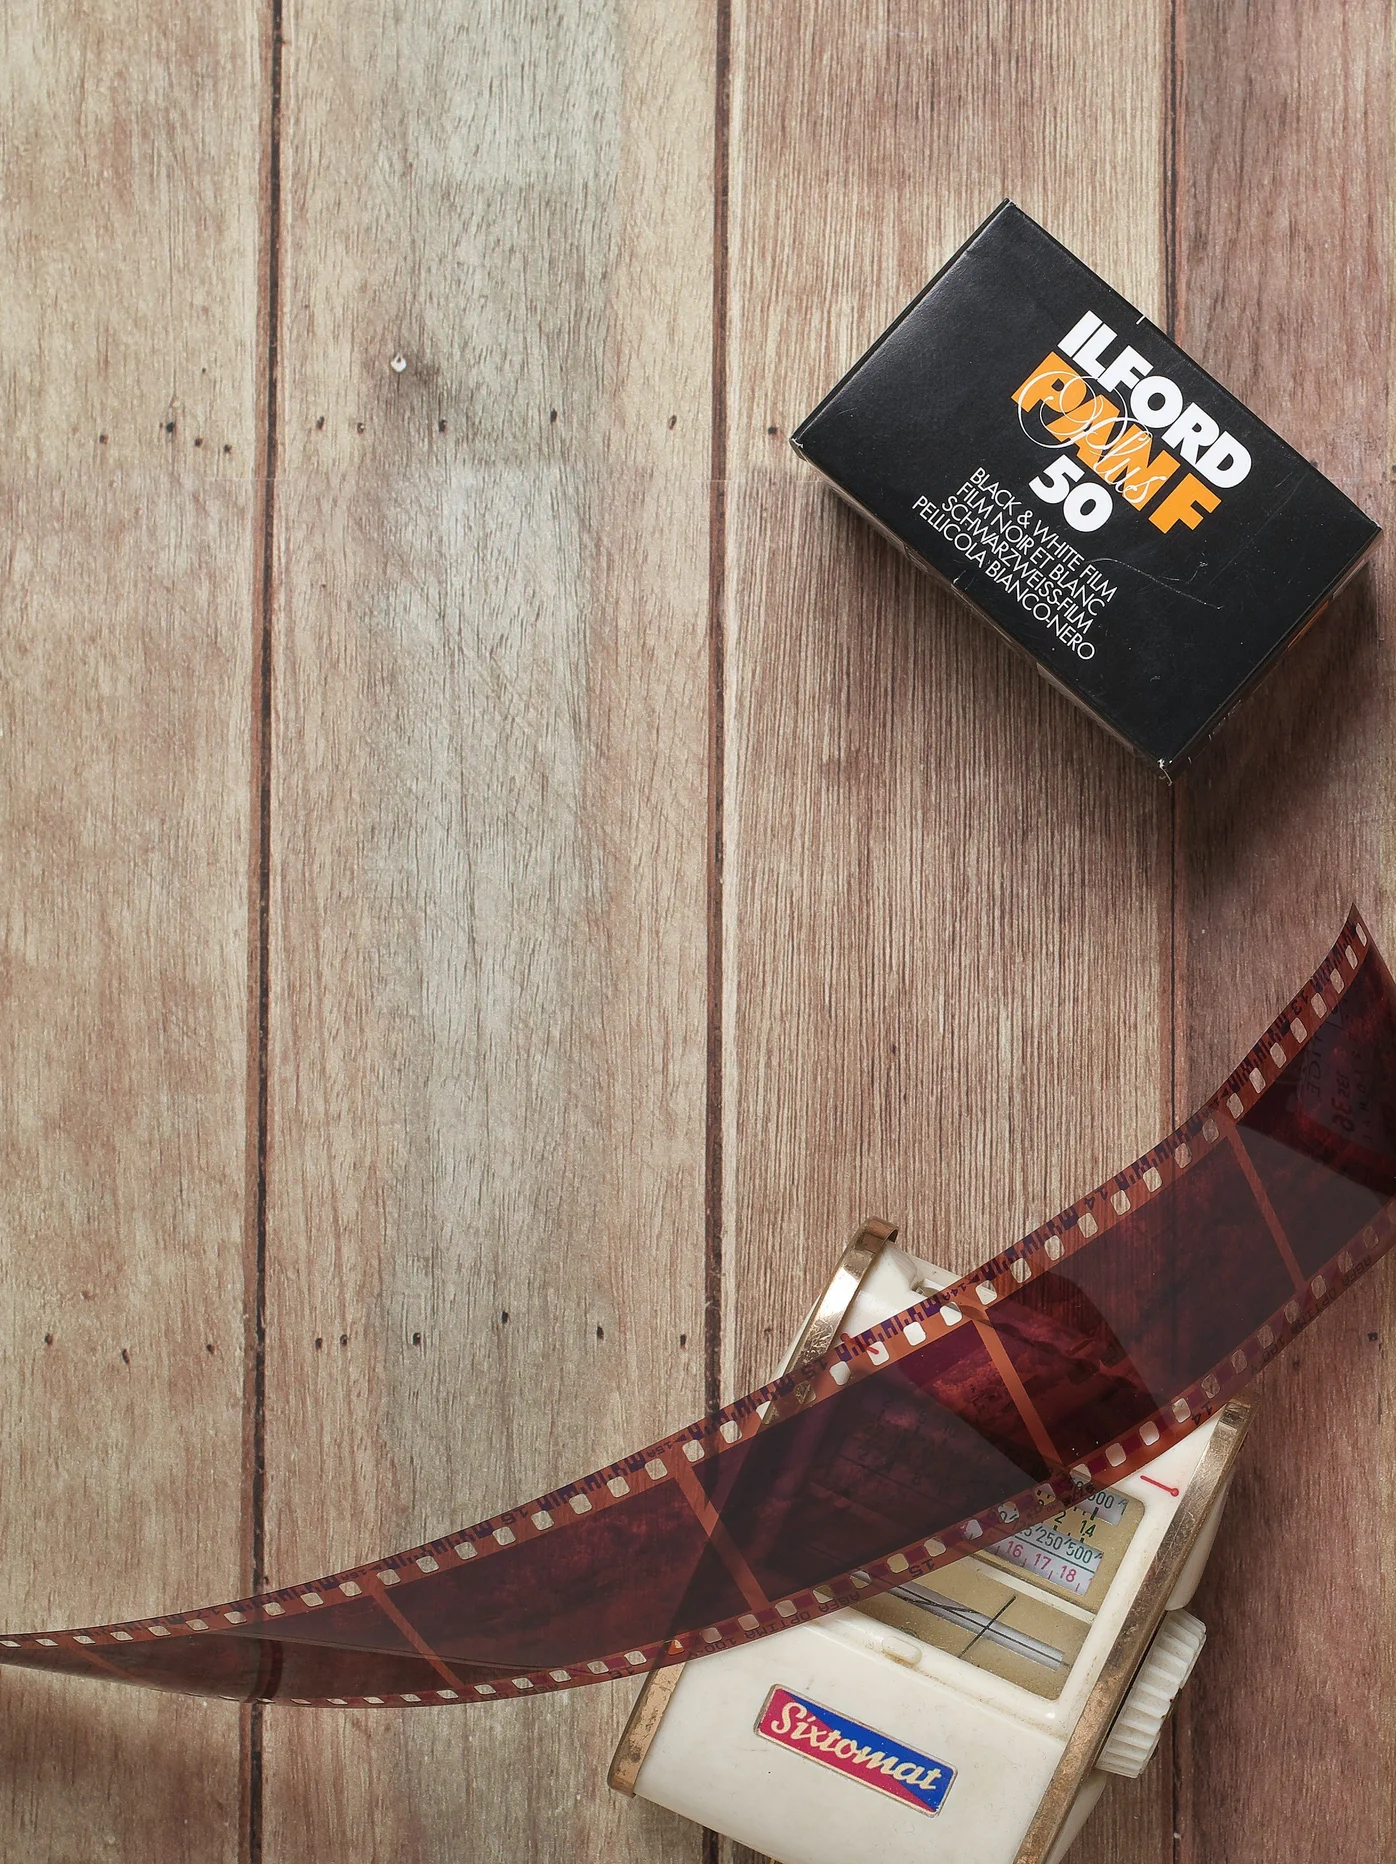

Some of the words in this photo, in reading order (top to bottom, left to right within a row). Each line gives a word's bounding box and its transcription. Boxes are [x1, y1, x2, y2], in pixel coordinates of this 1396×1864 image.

[1057, 309, 1252, 489] ILFORD
[1010, 351, 1181, 512] PAN
[1148, 472, 1222, 534] F
[1028, 454, 1113, 532] 50
[942, 495, 1094, 635] SCHWARZWEISS-FILM
[956, 482, 995, 519] FILM
[990, 512, 1035, 555] NOIR
[1029, 546, 1055, 569] ET
[1049, 563, 1106, 616] BLANC
[969, 467, 1022, 516] BLACK
[1017, 510, 1033, 529] &
[1033, 519, 1085, 572] WHITE
[1079, 565, 1118, 603] FILM
[912, 495, 987, 569] PELLICOLA
[985, 560, 1095, 660] BIANCO-NERO
[941, 1282, 968, 1303] 14A
[1191, 1403, 1214, 1427] 14
[1054, 1510, 1066, 1524] 2
[908, 1557, 936, 1578] 15
[1008, 1541, 1023, 1557] 16
[1034, 1553, 1051, 1570] 17
[1060, 1565, 1076, 1582] 18
[746, 1609, 812, 1640] OPTIMA
[818, 1591, 861, 1614] AGFA
[771, 1702, 942, 1790] Sixtomat
